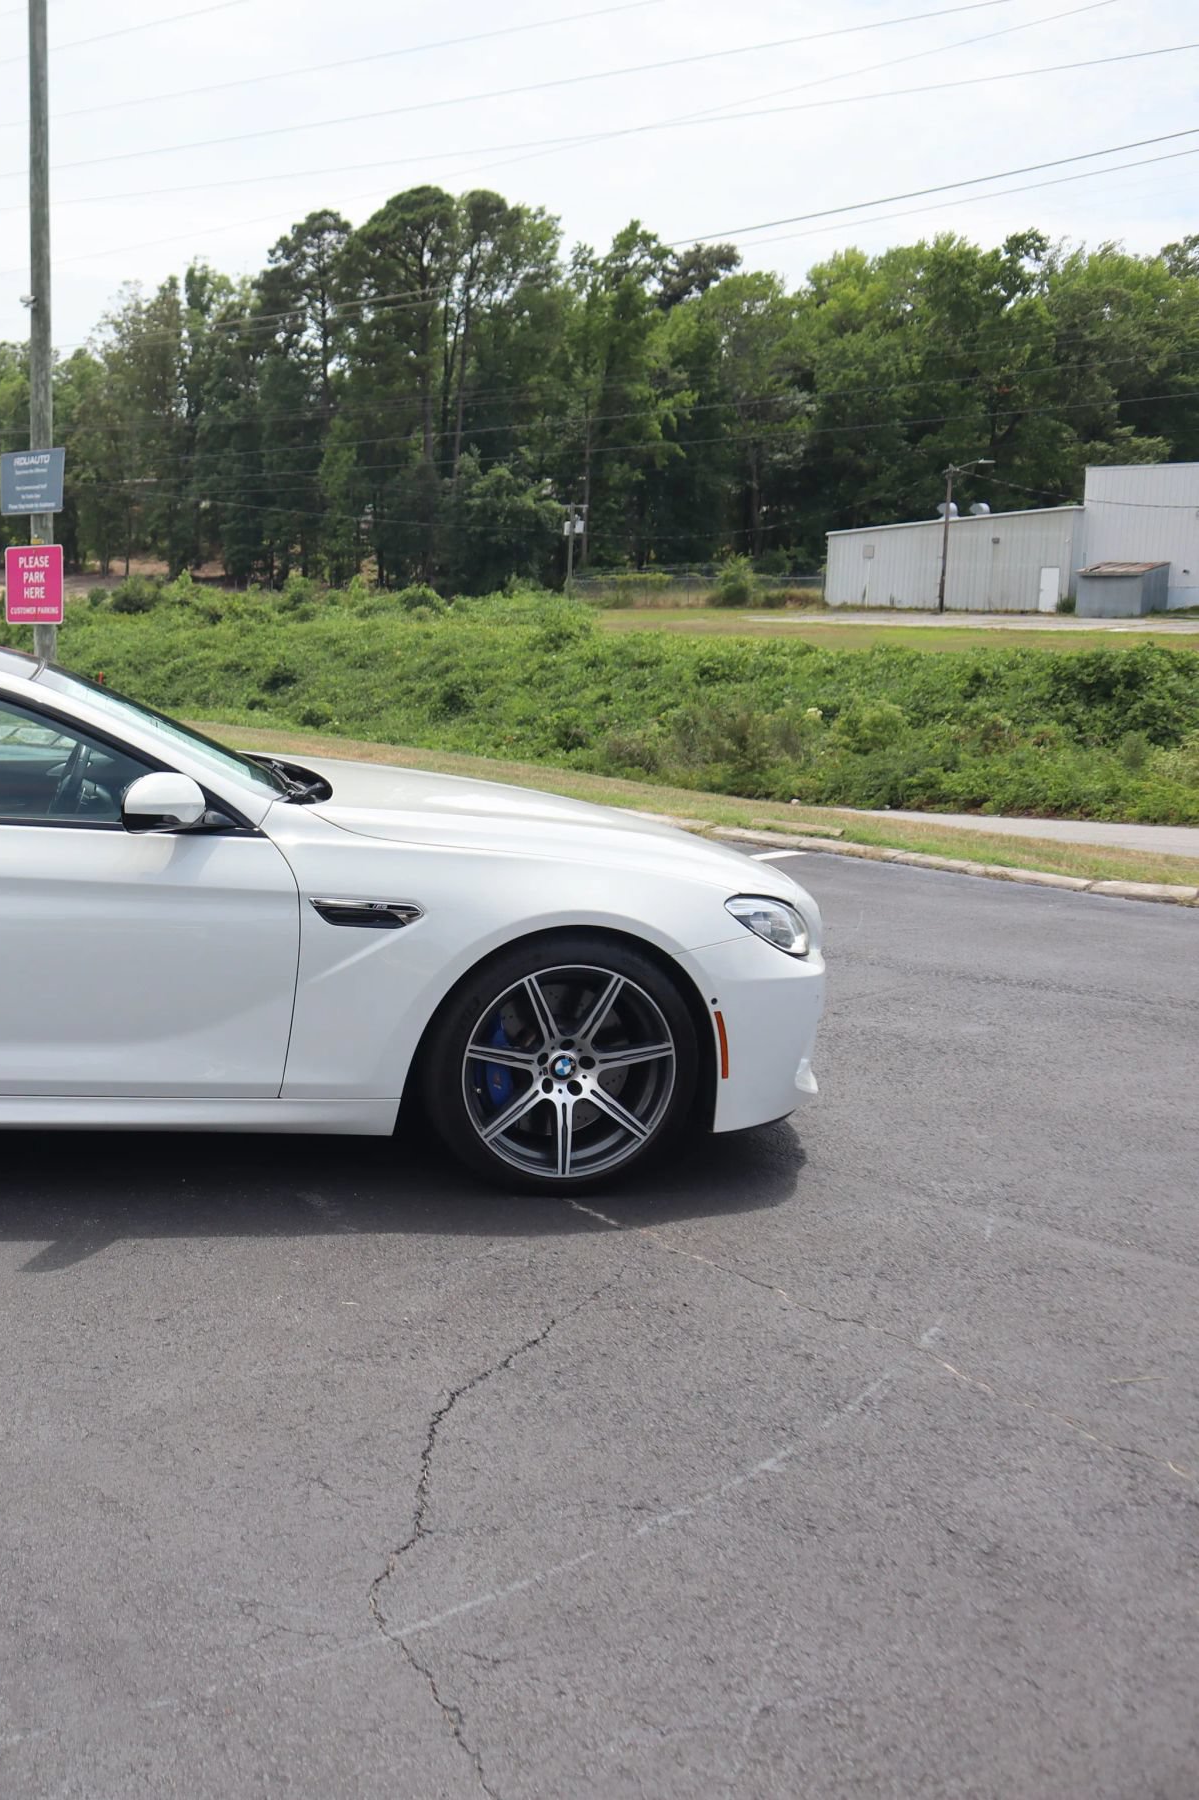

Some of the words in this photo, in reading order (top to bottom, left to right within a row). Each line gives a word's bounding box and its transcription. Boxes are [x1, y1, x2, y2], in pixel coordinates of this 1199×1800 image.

[18, 555, 50, 569] PLEASE
[23, 571, 46, 584] PARK
[23, 586, 46, 599] HERE
[10, 606, 37, 615] CUSTOMER
[37, 606, 59, 615] PARKING
